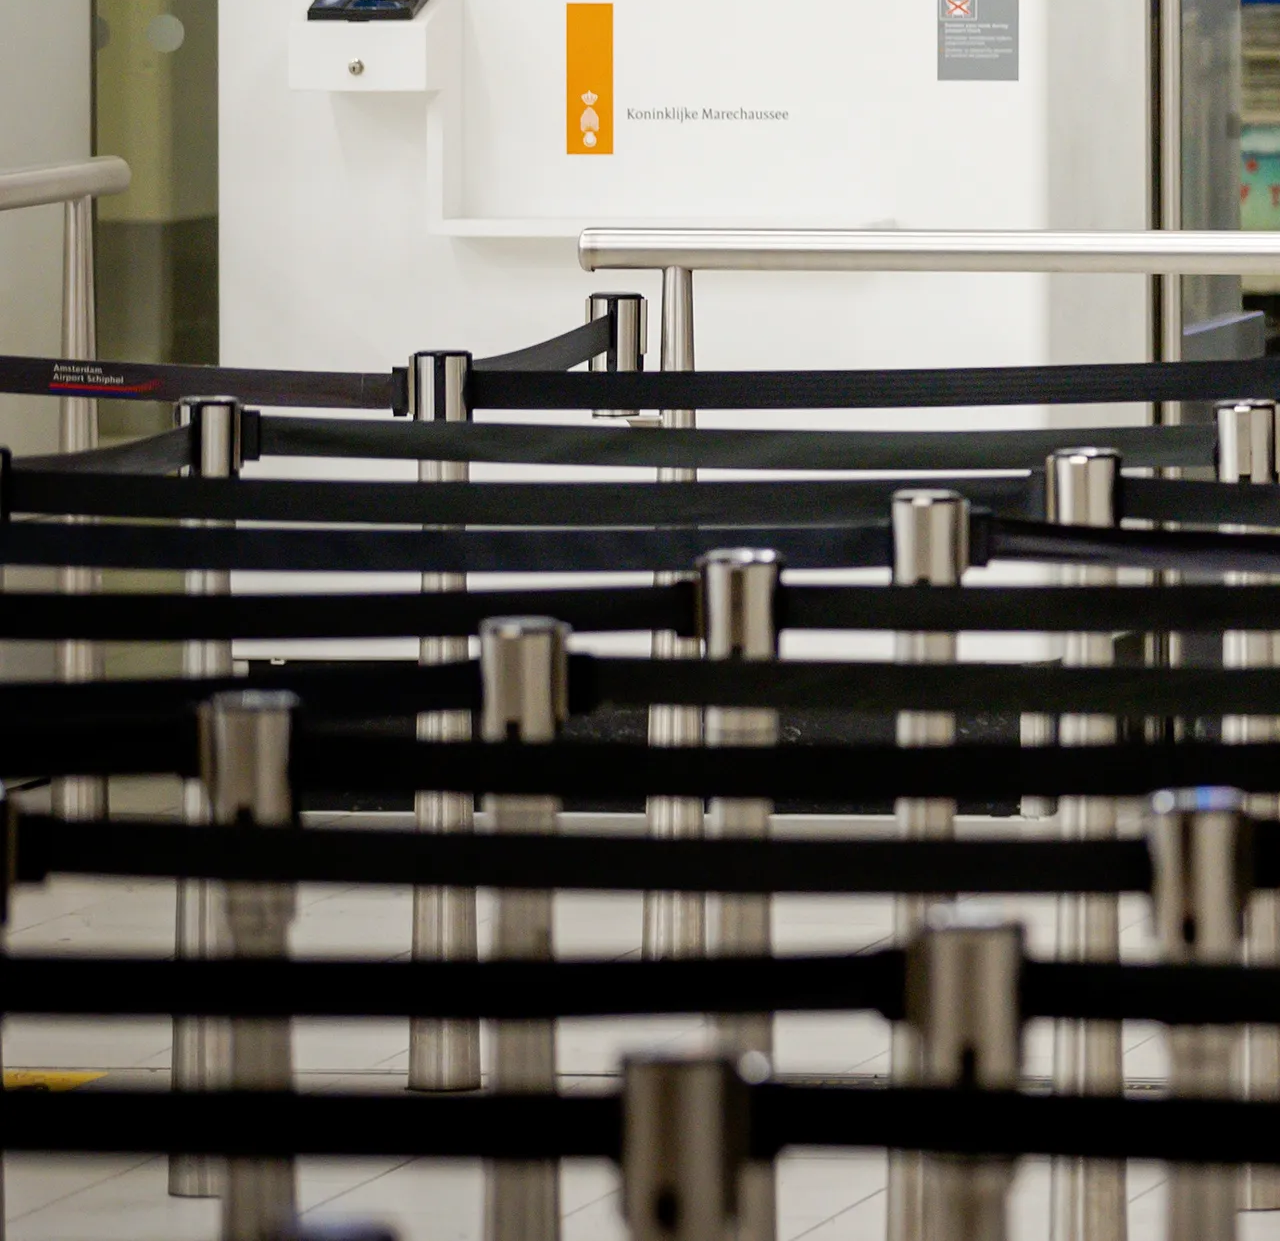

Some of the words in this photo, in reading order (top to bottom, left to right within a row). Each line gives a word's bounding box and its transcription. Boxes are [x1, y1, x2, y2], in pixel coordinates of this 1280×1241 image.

[627, 107, 698, 123] Koninklijke
[702, 107, 789, 120] Marechaussee
[53, 364, 103, 374] Amsterdam
[53, 373, 84, 383] Airport
[87, 375, 124, 384] Schiphol
